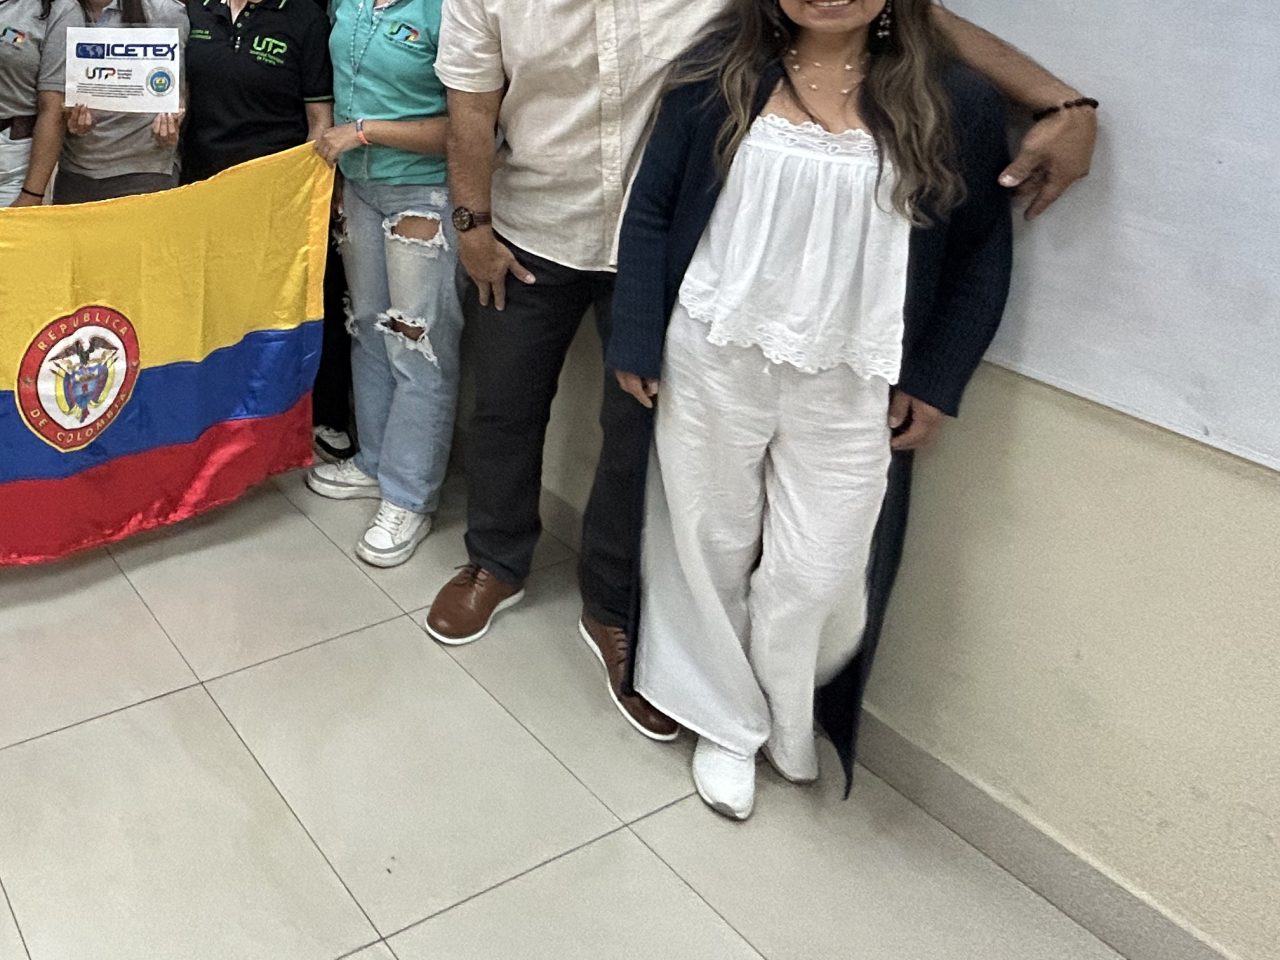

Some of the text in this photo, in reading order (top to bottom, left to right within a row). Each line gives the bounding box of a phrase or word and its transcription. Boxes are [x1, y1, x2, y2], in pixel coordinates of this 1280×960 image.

[106, 43, 178, 61] ICETEX
[253, 34, 288, 55] UTP
[85, 66, 117, 80] UTP
[37, 312, 129, 352] REPUBLICA
[30, 393, 126, 444] DE COLOMBIA
